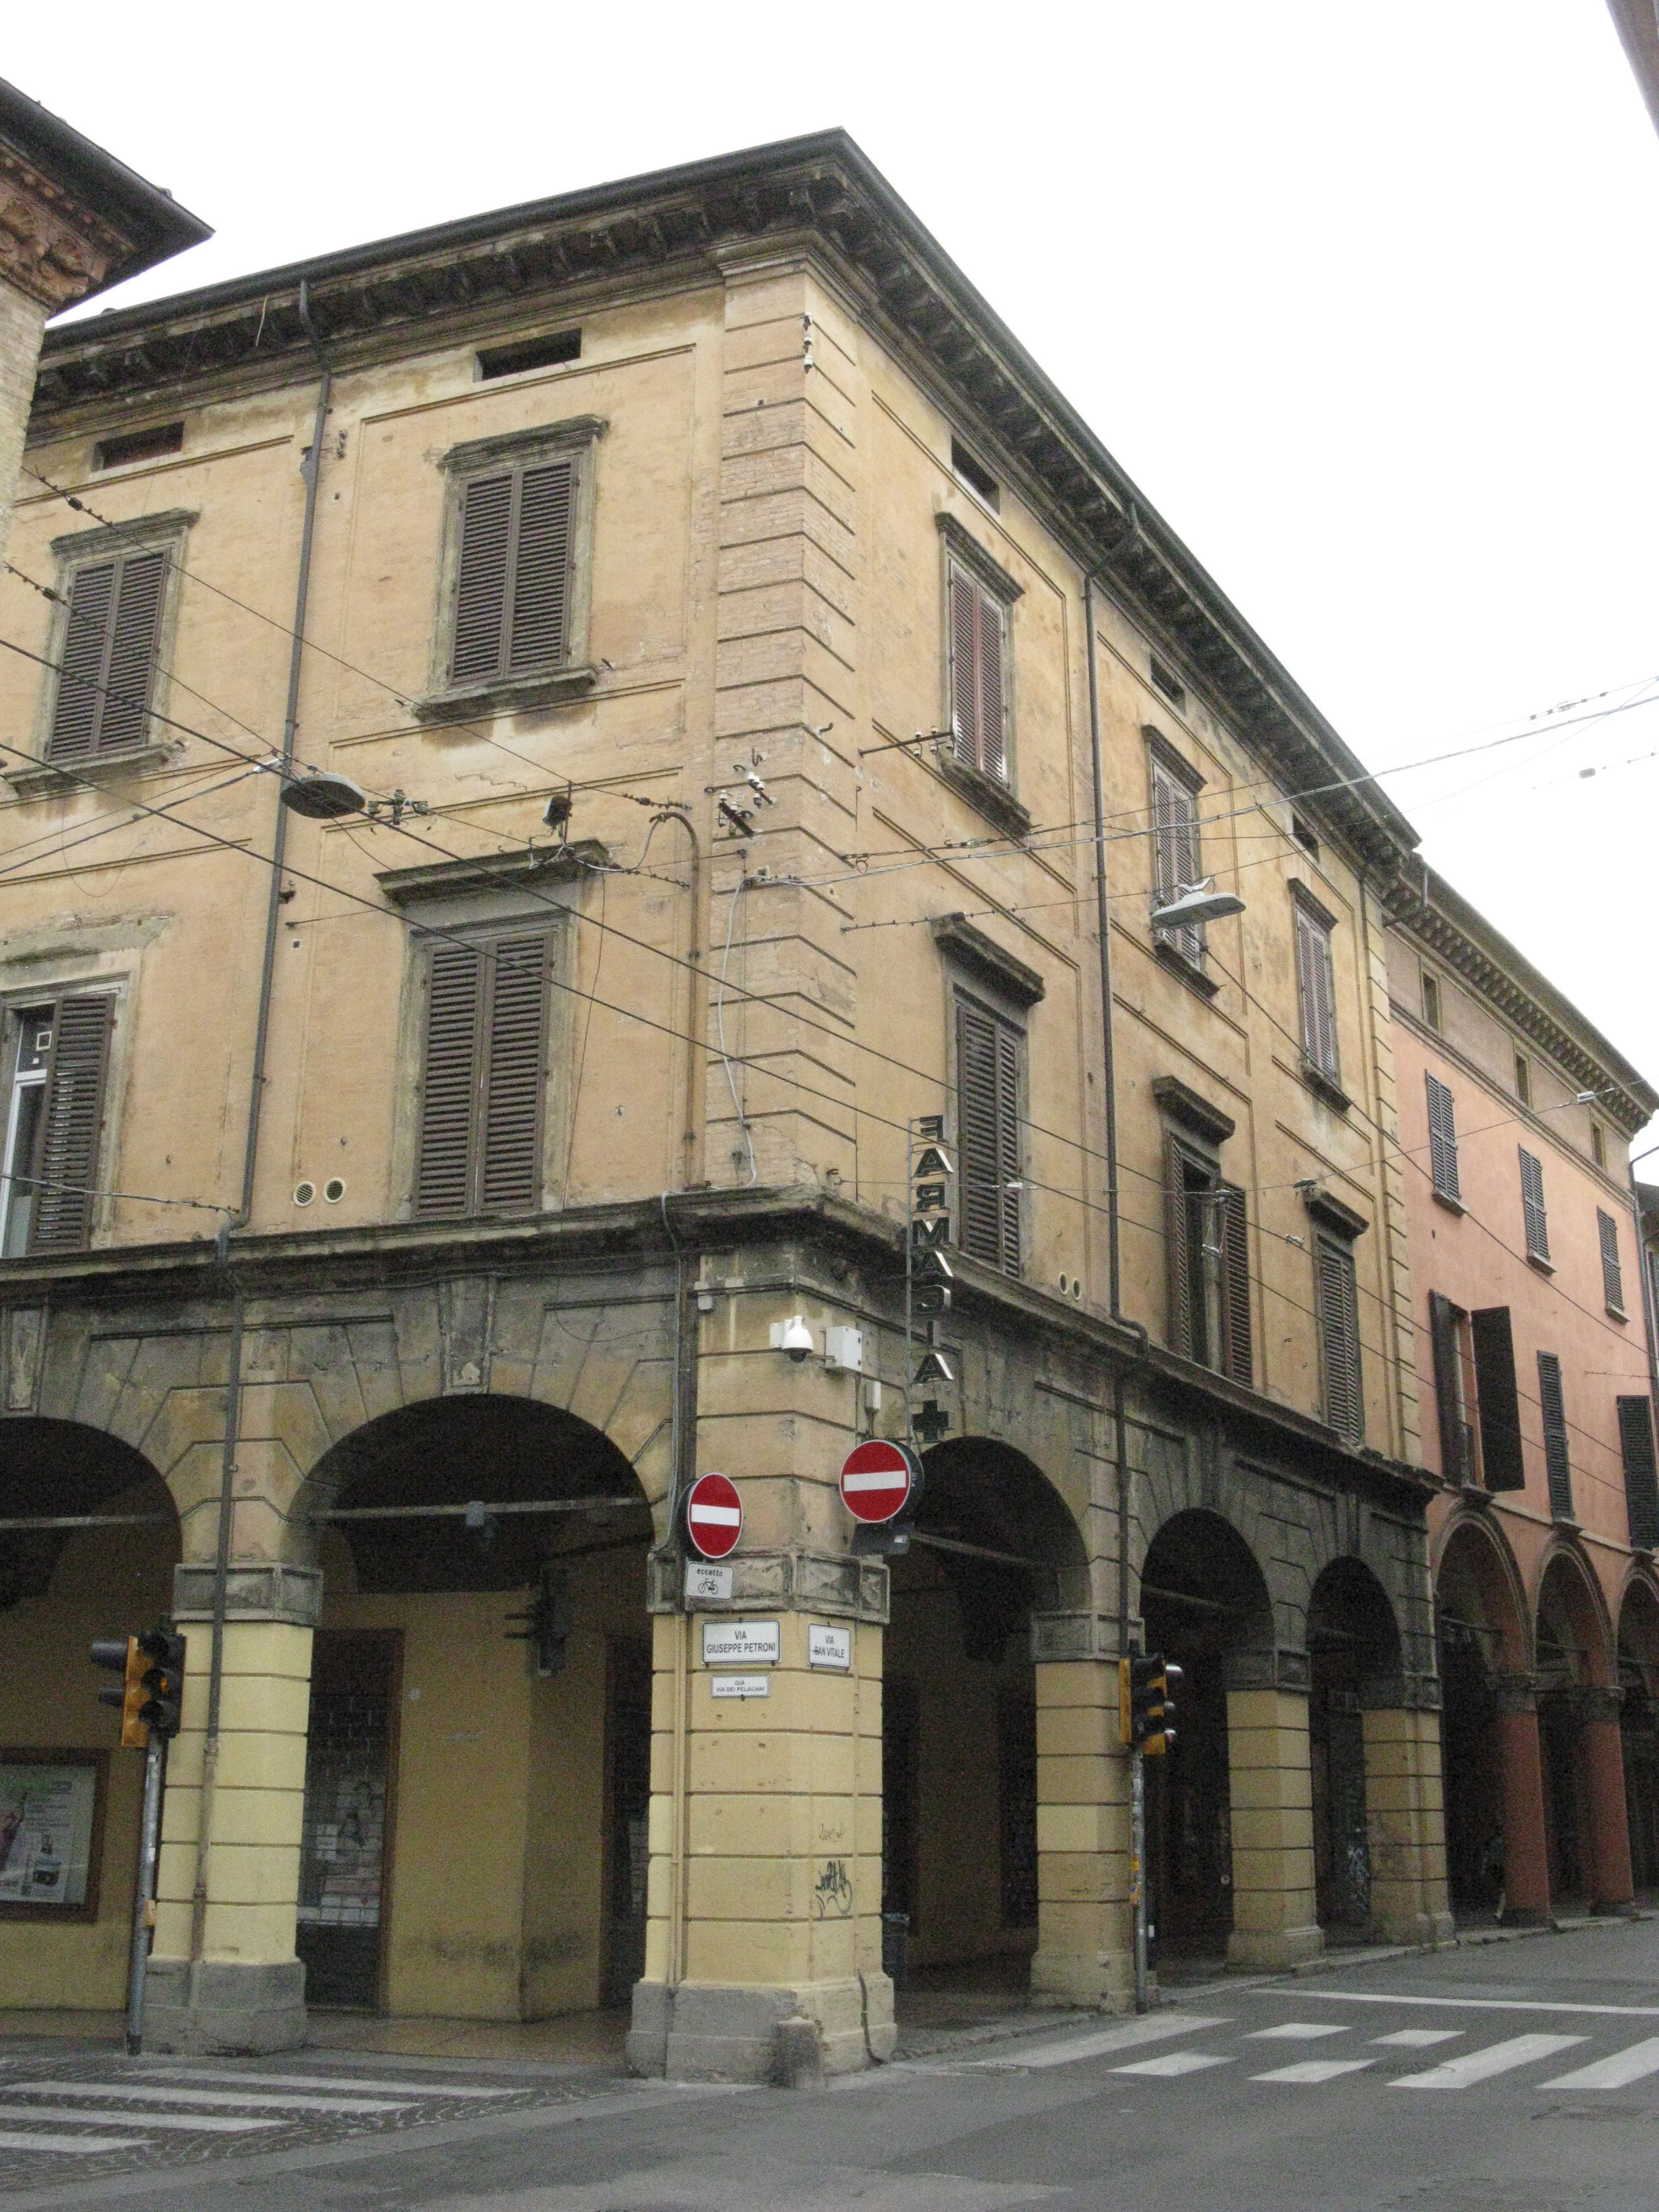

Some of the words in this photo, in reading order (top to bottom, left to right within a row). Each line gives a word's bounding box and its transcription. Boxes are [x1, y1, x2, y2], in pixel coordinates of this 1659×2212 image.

[697, 1568, 723, 1576] eccetto
[735, 1631, 746, 1640] VIA
[825, 1635, 834, 1645] VIA
[707, 1643, 742, 1653] GIUSEPPE
[744, 1642, 775, 1652] PETRONI
[814, 1646, 825, 1656] SAN
[827, 1647, 845, 1658] VITALE
